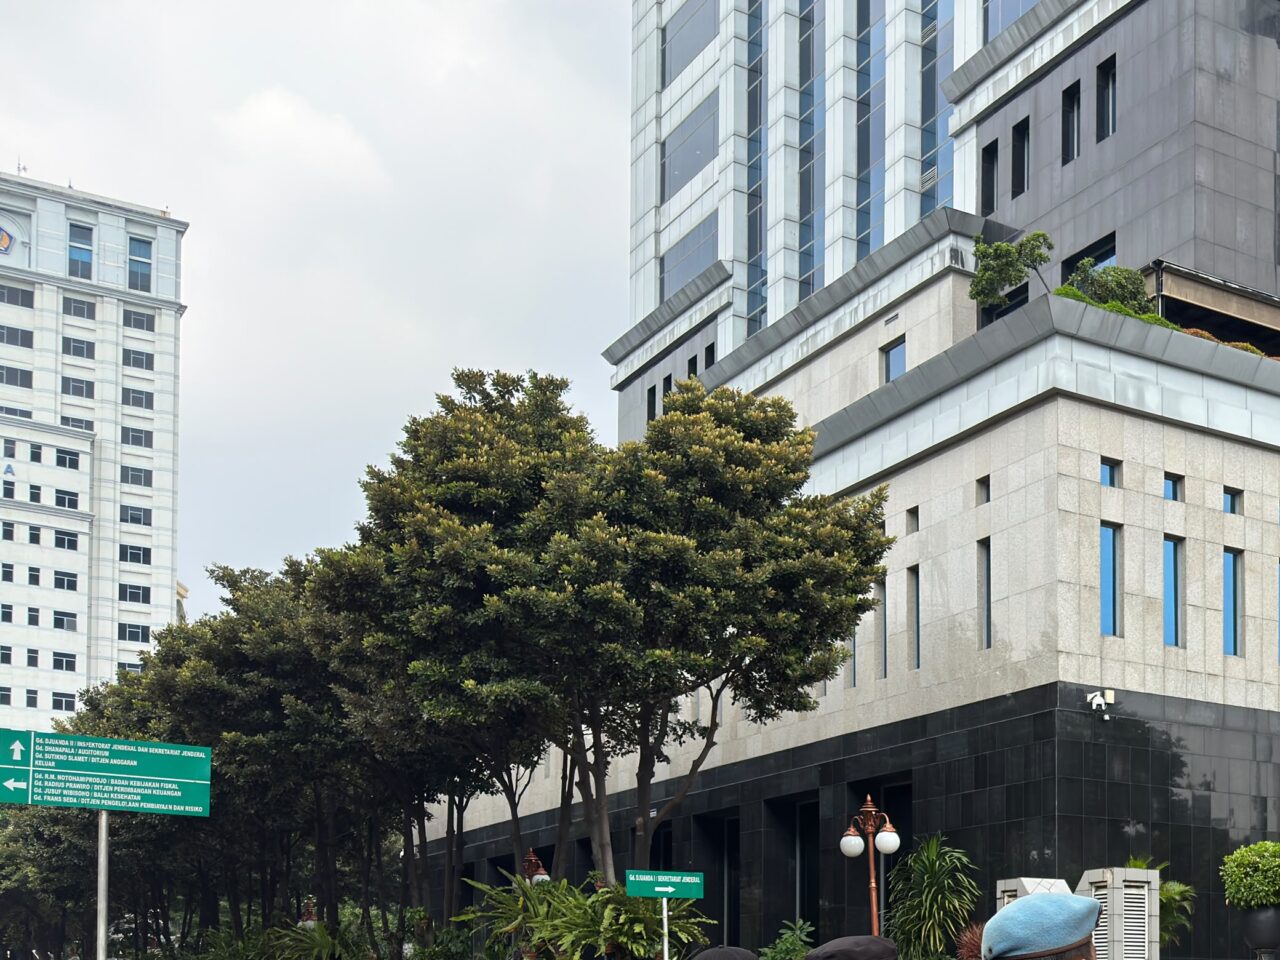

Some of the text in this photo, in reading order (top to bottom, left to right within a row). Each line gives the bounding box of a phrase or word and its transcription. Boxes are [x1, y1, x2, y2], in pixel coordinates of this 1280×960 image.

[4, 464, 15, 476] A
[77, 741, 110, 749] INSPEKTORAT
[112, 744, 136, 752] JENDERAL
[57, 775, 107, 783] NOTOHAMIPRODJO
[114, 786, 151, 794] PERIMBANGAN
[101, 799, 139, 807] PENGELOLAAN
